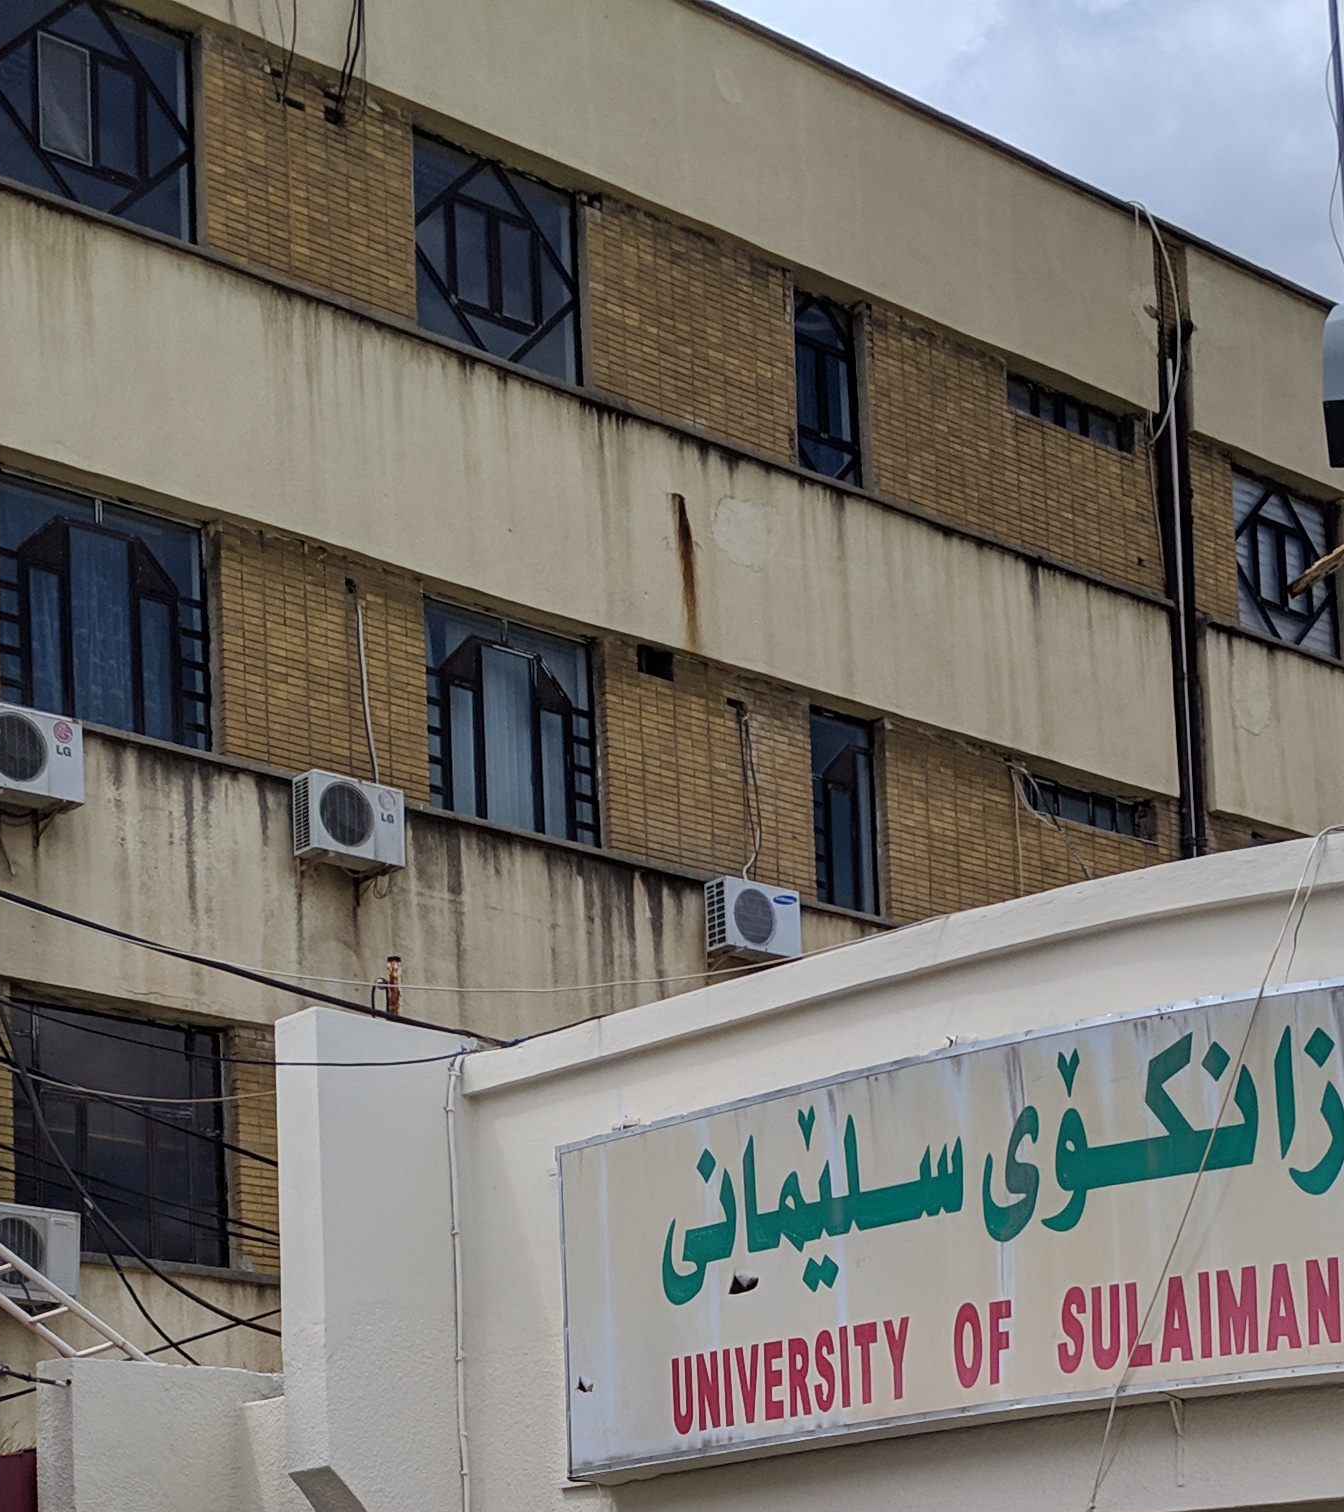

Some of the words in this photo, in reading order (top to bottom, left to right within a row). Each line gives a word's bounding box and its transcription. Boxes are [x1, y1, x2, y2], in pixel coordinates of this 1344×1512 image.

[55, 744, 72, 758] LG
[662, 1104, 964, 1306] سلێمانی
[671, 1315, 911, 1436] UNIVERSITY
[954, 1299, 1013, 1389] OF
